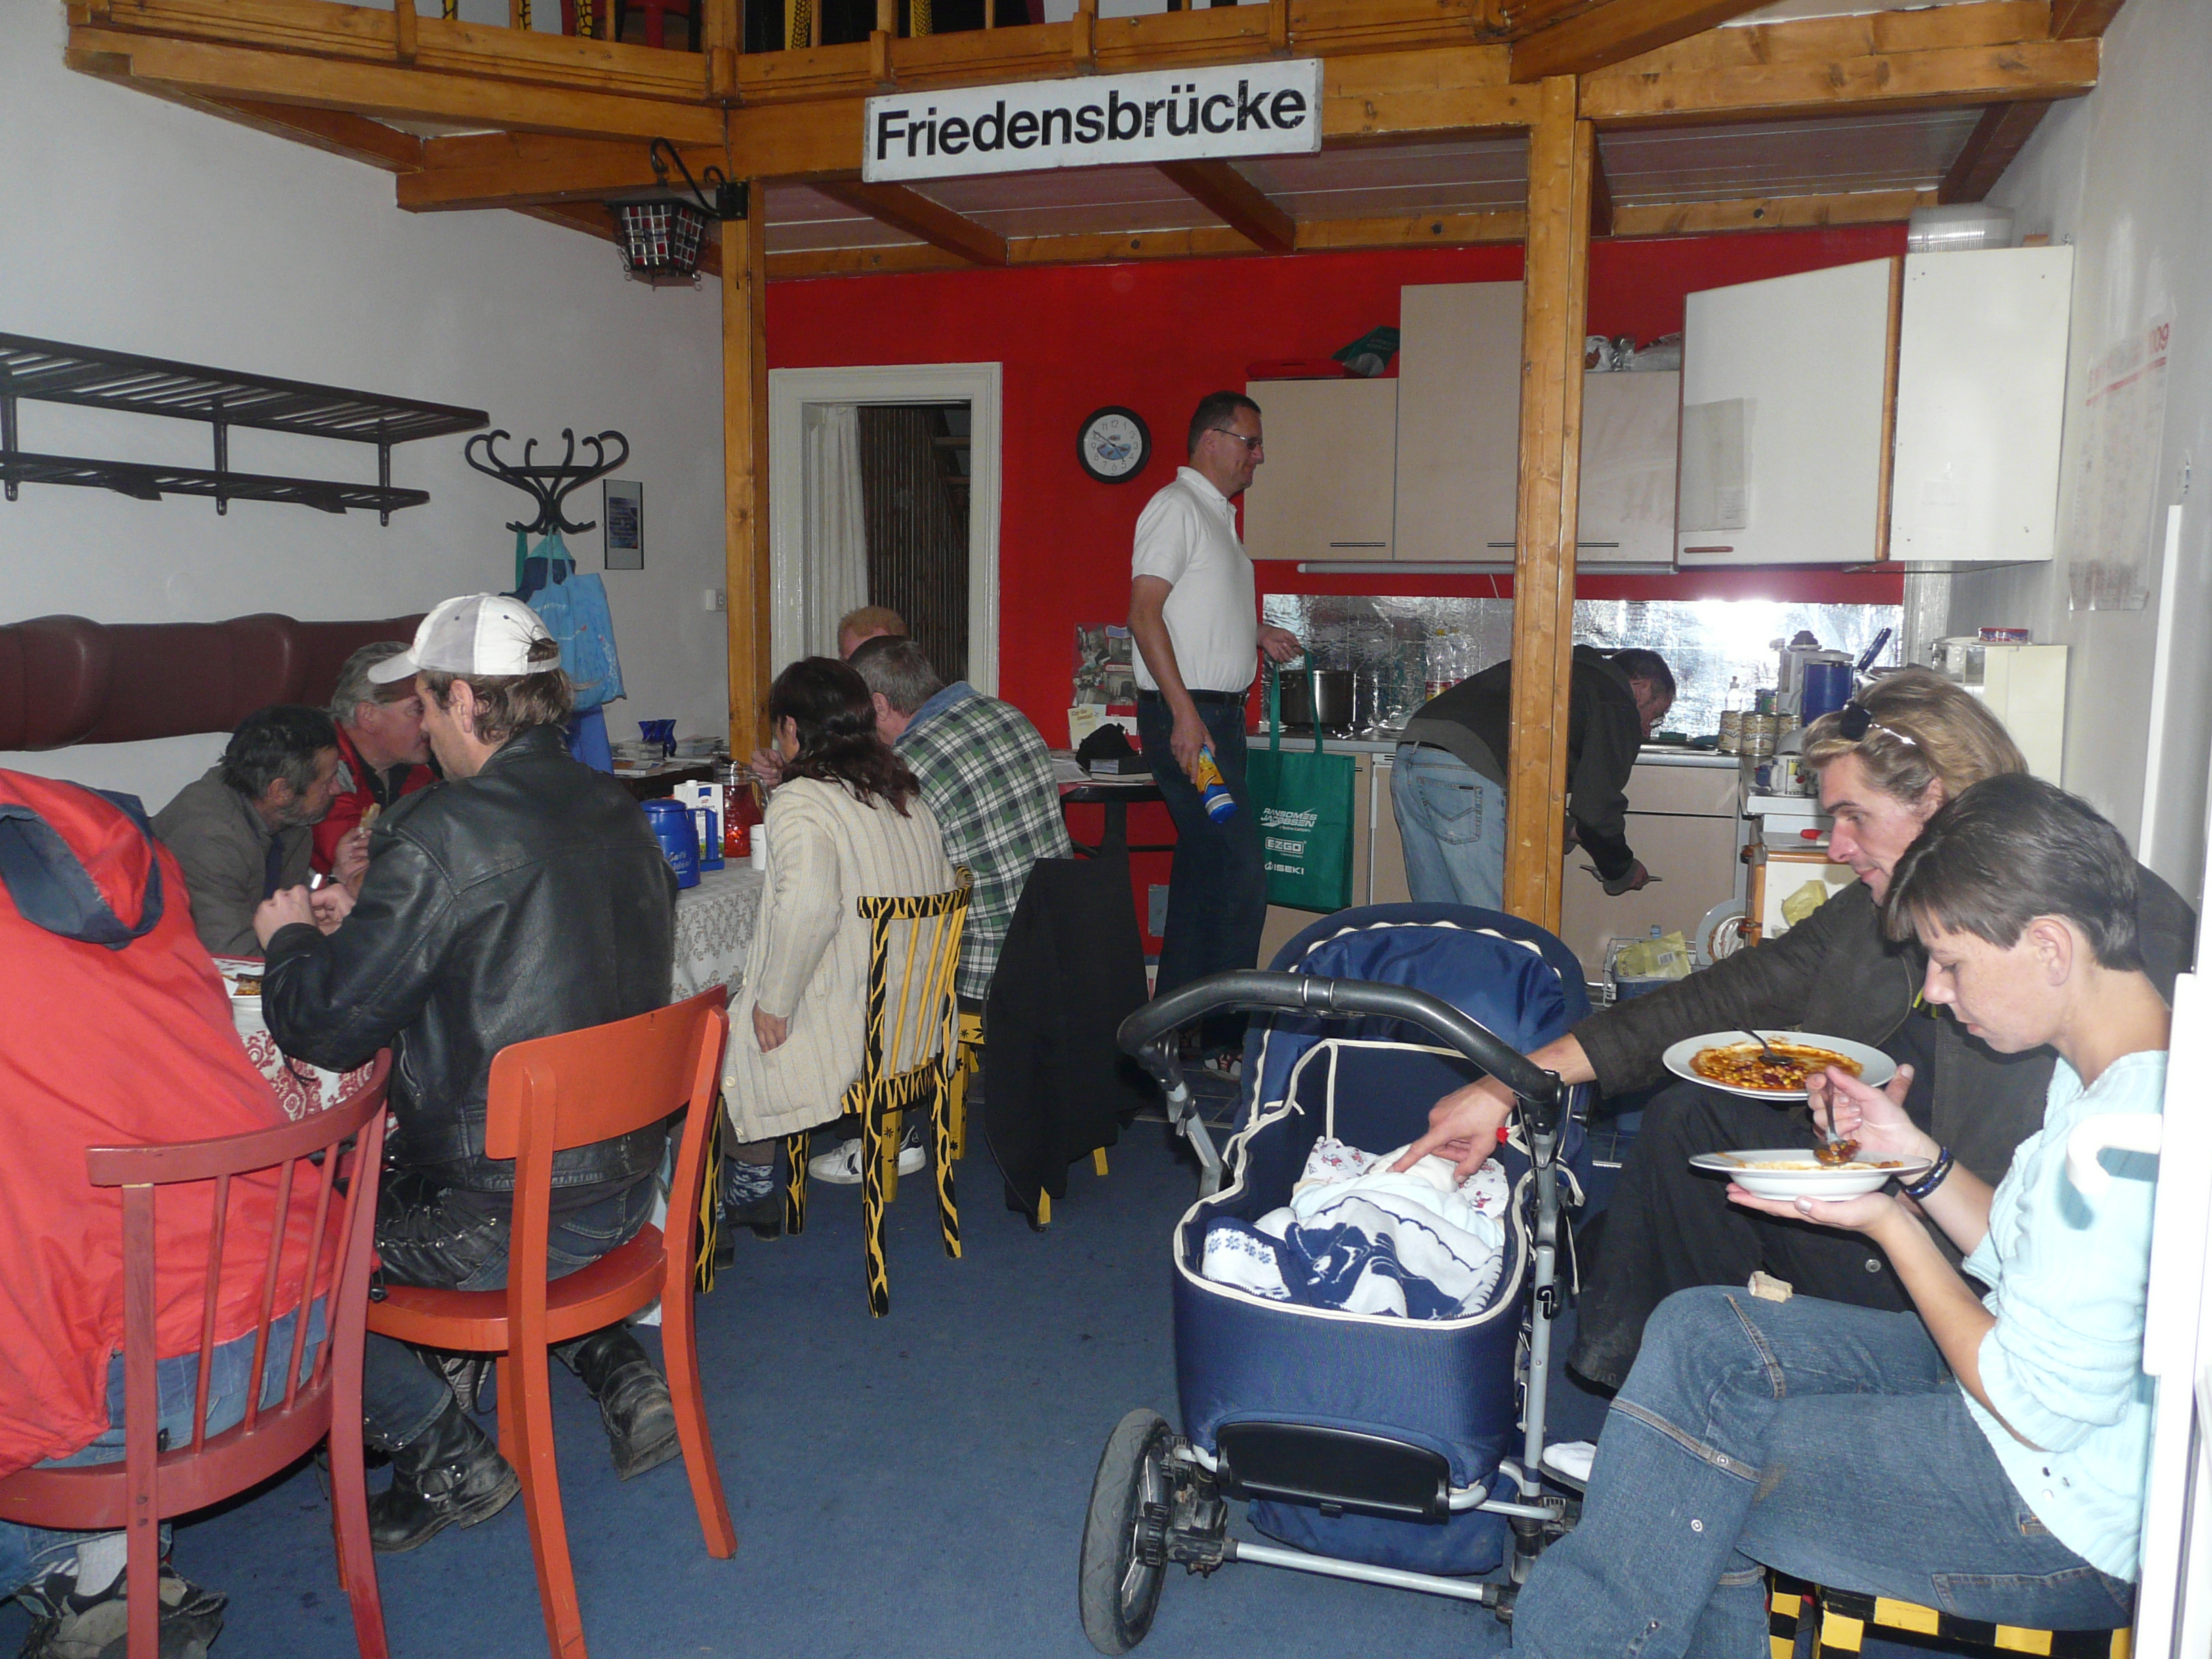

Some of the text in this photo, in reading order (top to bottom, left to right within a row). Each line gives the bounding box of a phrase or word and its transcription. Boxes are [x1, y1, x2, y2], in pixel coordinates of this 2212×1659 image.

[877, 79, 1307, 161] Friedensbrücke
[1263, 808, 1317, 821] RANSOMES
[1261, 815, 1315, 827] JACOBSEN
[1274, 863, 1304, 874] ISEKI
